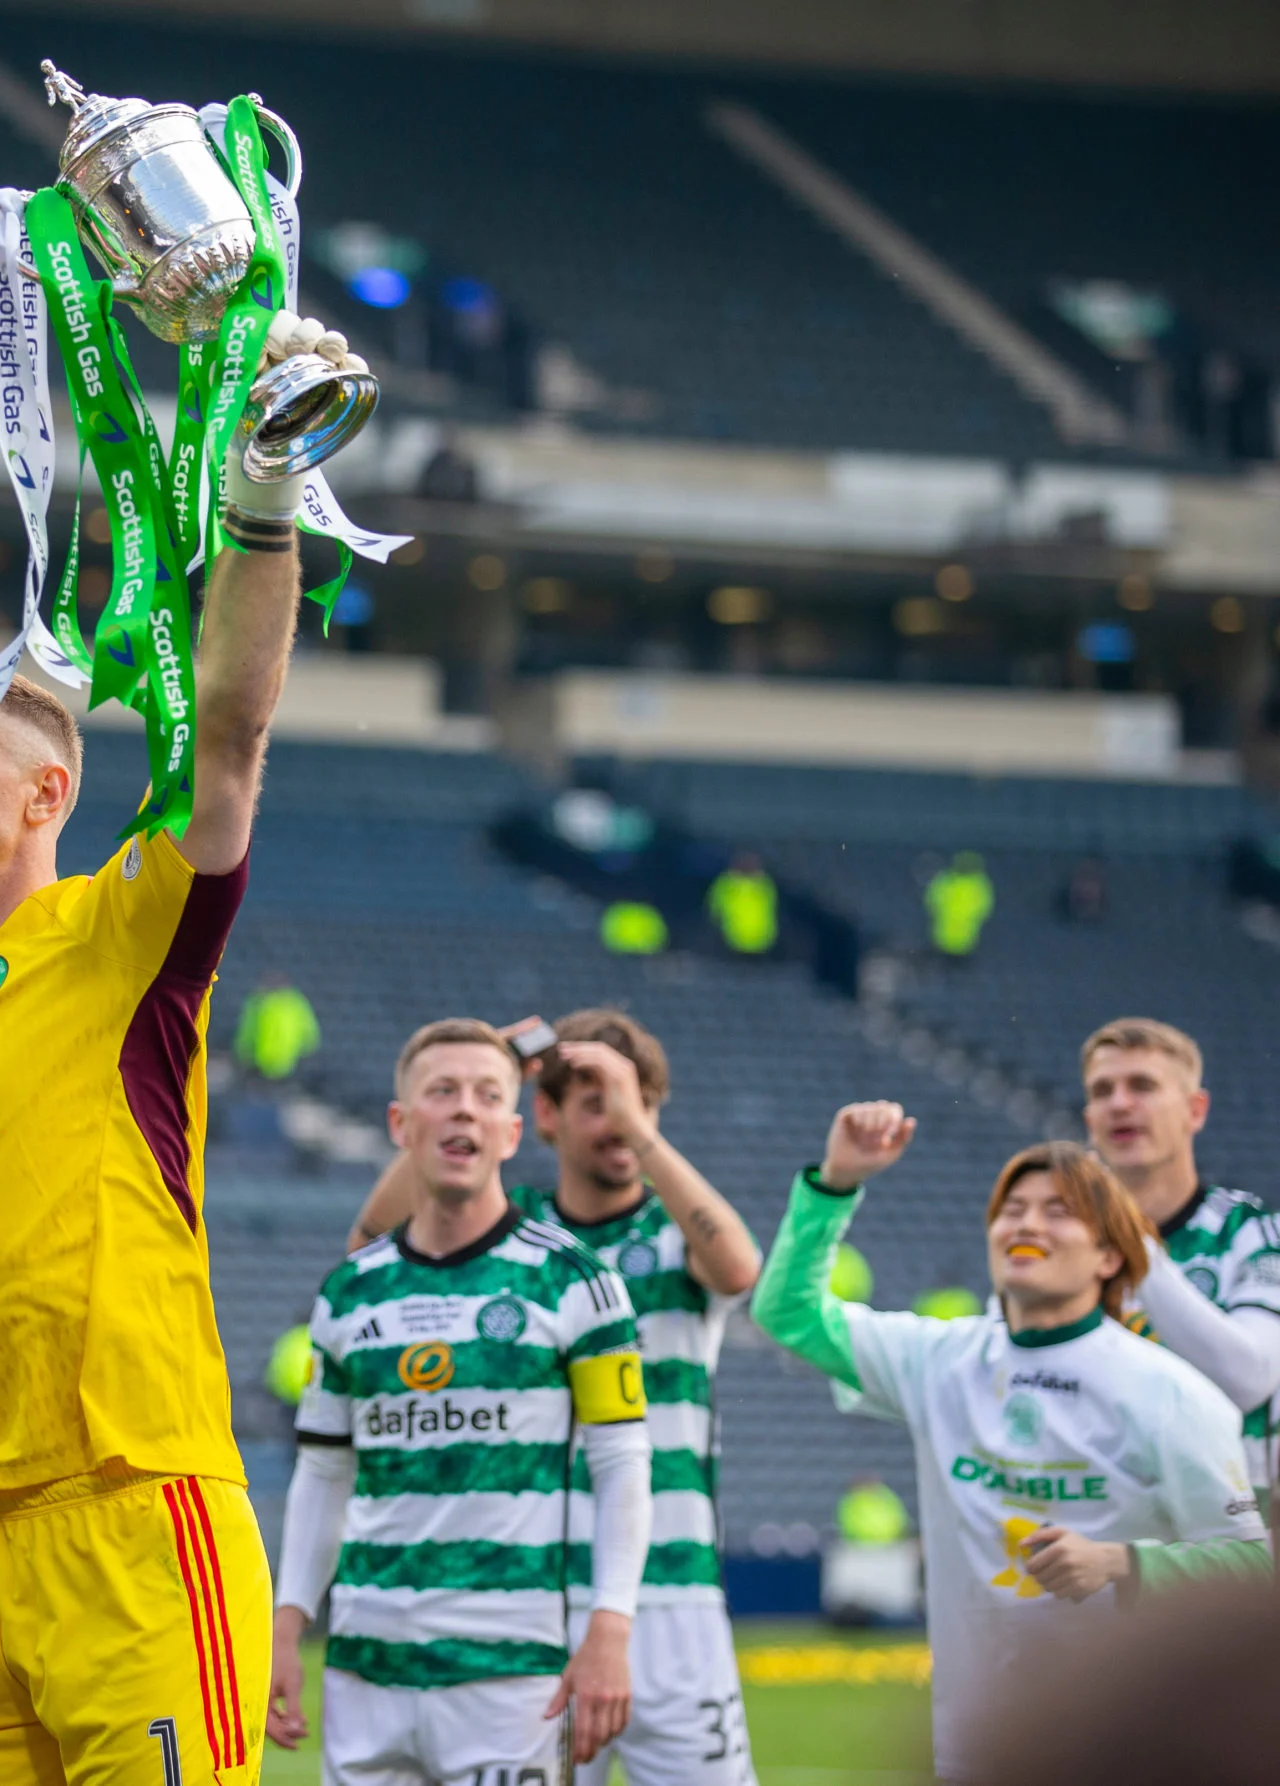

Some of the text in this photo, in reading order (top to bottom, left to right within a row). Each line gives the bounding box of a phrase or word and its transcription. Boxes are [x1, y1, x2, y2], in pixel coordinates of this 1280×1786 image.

[234, 131, 264, 213] Scottish
[48, 241, 104, 398] Scottish Gas
[214, 314, 256, 414] Scottish
[2, 386, 25, 434] Gas
[112, 470, 145, 616] Scottish Gas
[303, 483, 332, 527] Gas
[57, 611, 80, 657] Gas
[150, 608, 190, 773] Scottish Gas
[367, 1398, 509, 1441] dafabet
